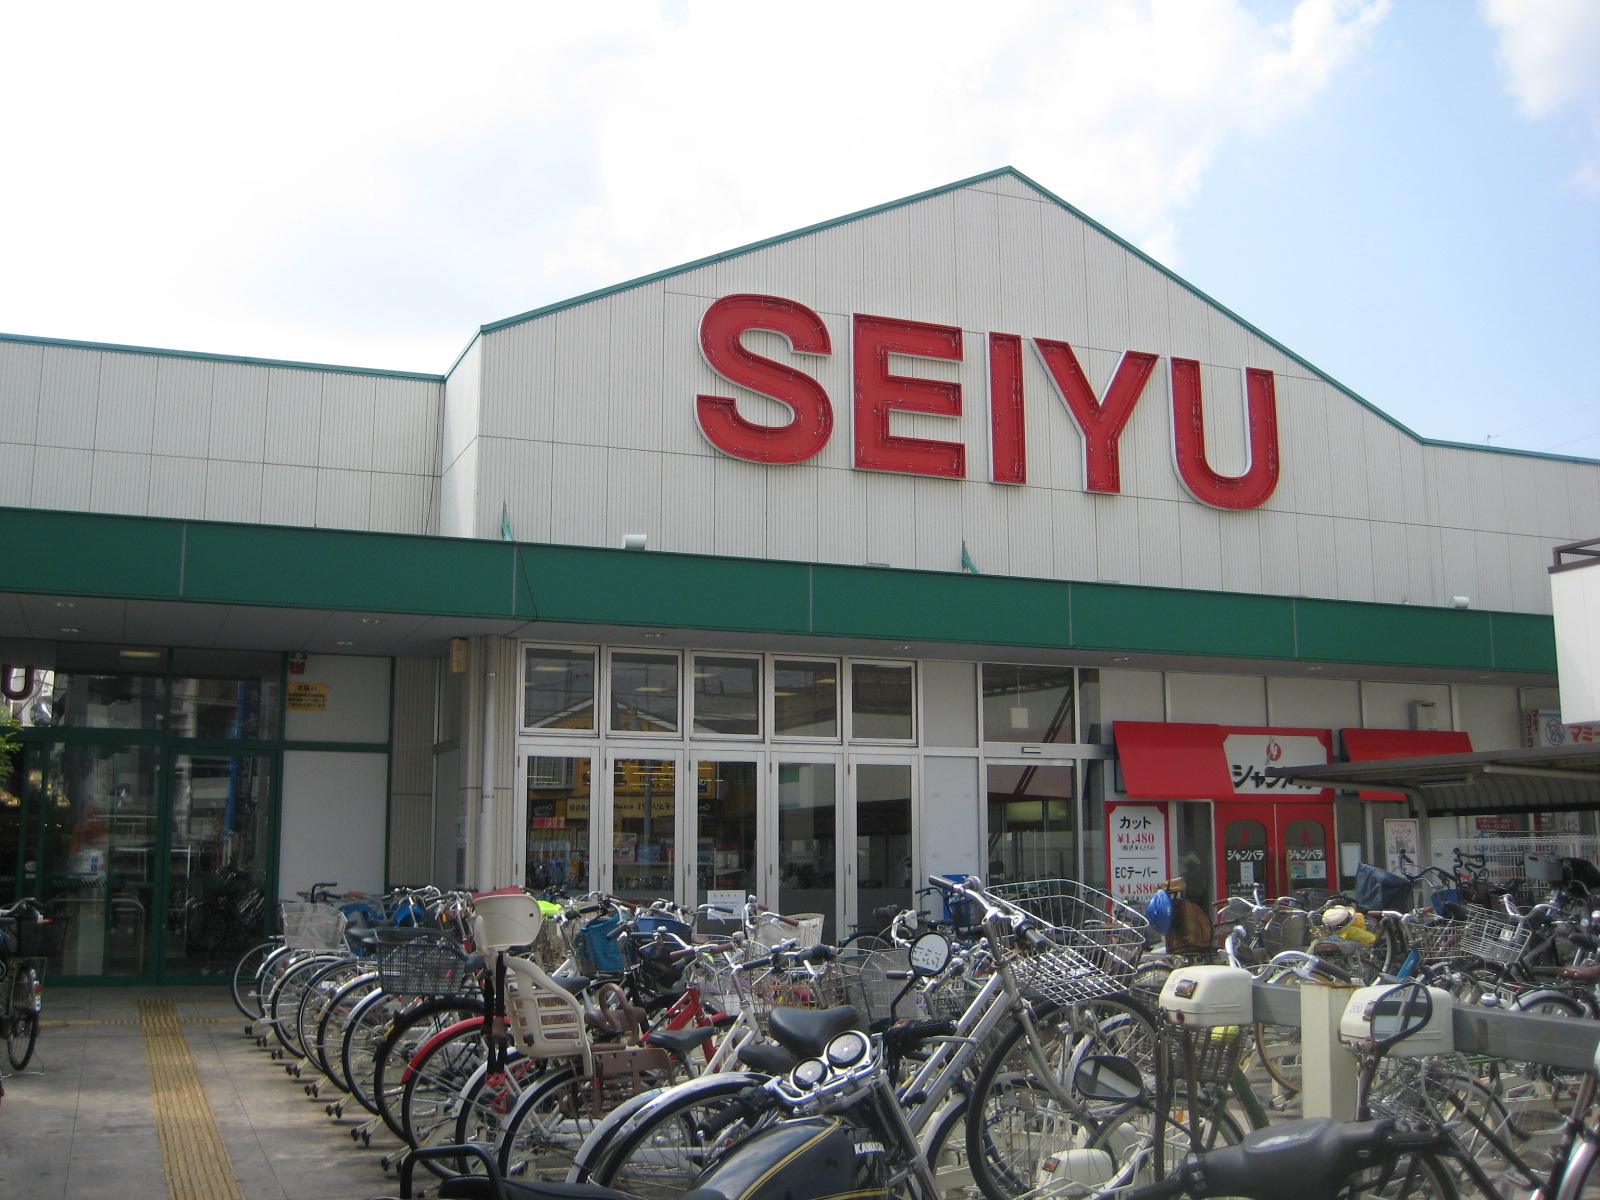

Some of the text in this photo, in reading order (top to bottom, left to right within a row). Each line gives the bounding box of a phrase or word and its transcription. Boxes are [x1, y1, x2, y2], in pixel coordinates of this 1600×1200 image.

[694, 293, 1280, 512] SEIYU
[1119, 816, 1151, 829] カット
[1117, 833, 1155, 844] ¥1,480
[1227, 849, 1264, 861] シャンバラ
[1288, 848, 1324, 860] シャンバラ
[1349, 1003, 1364, 1013] 200
